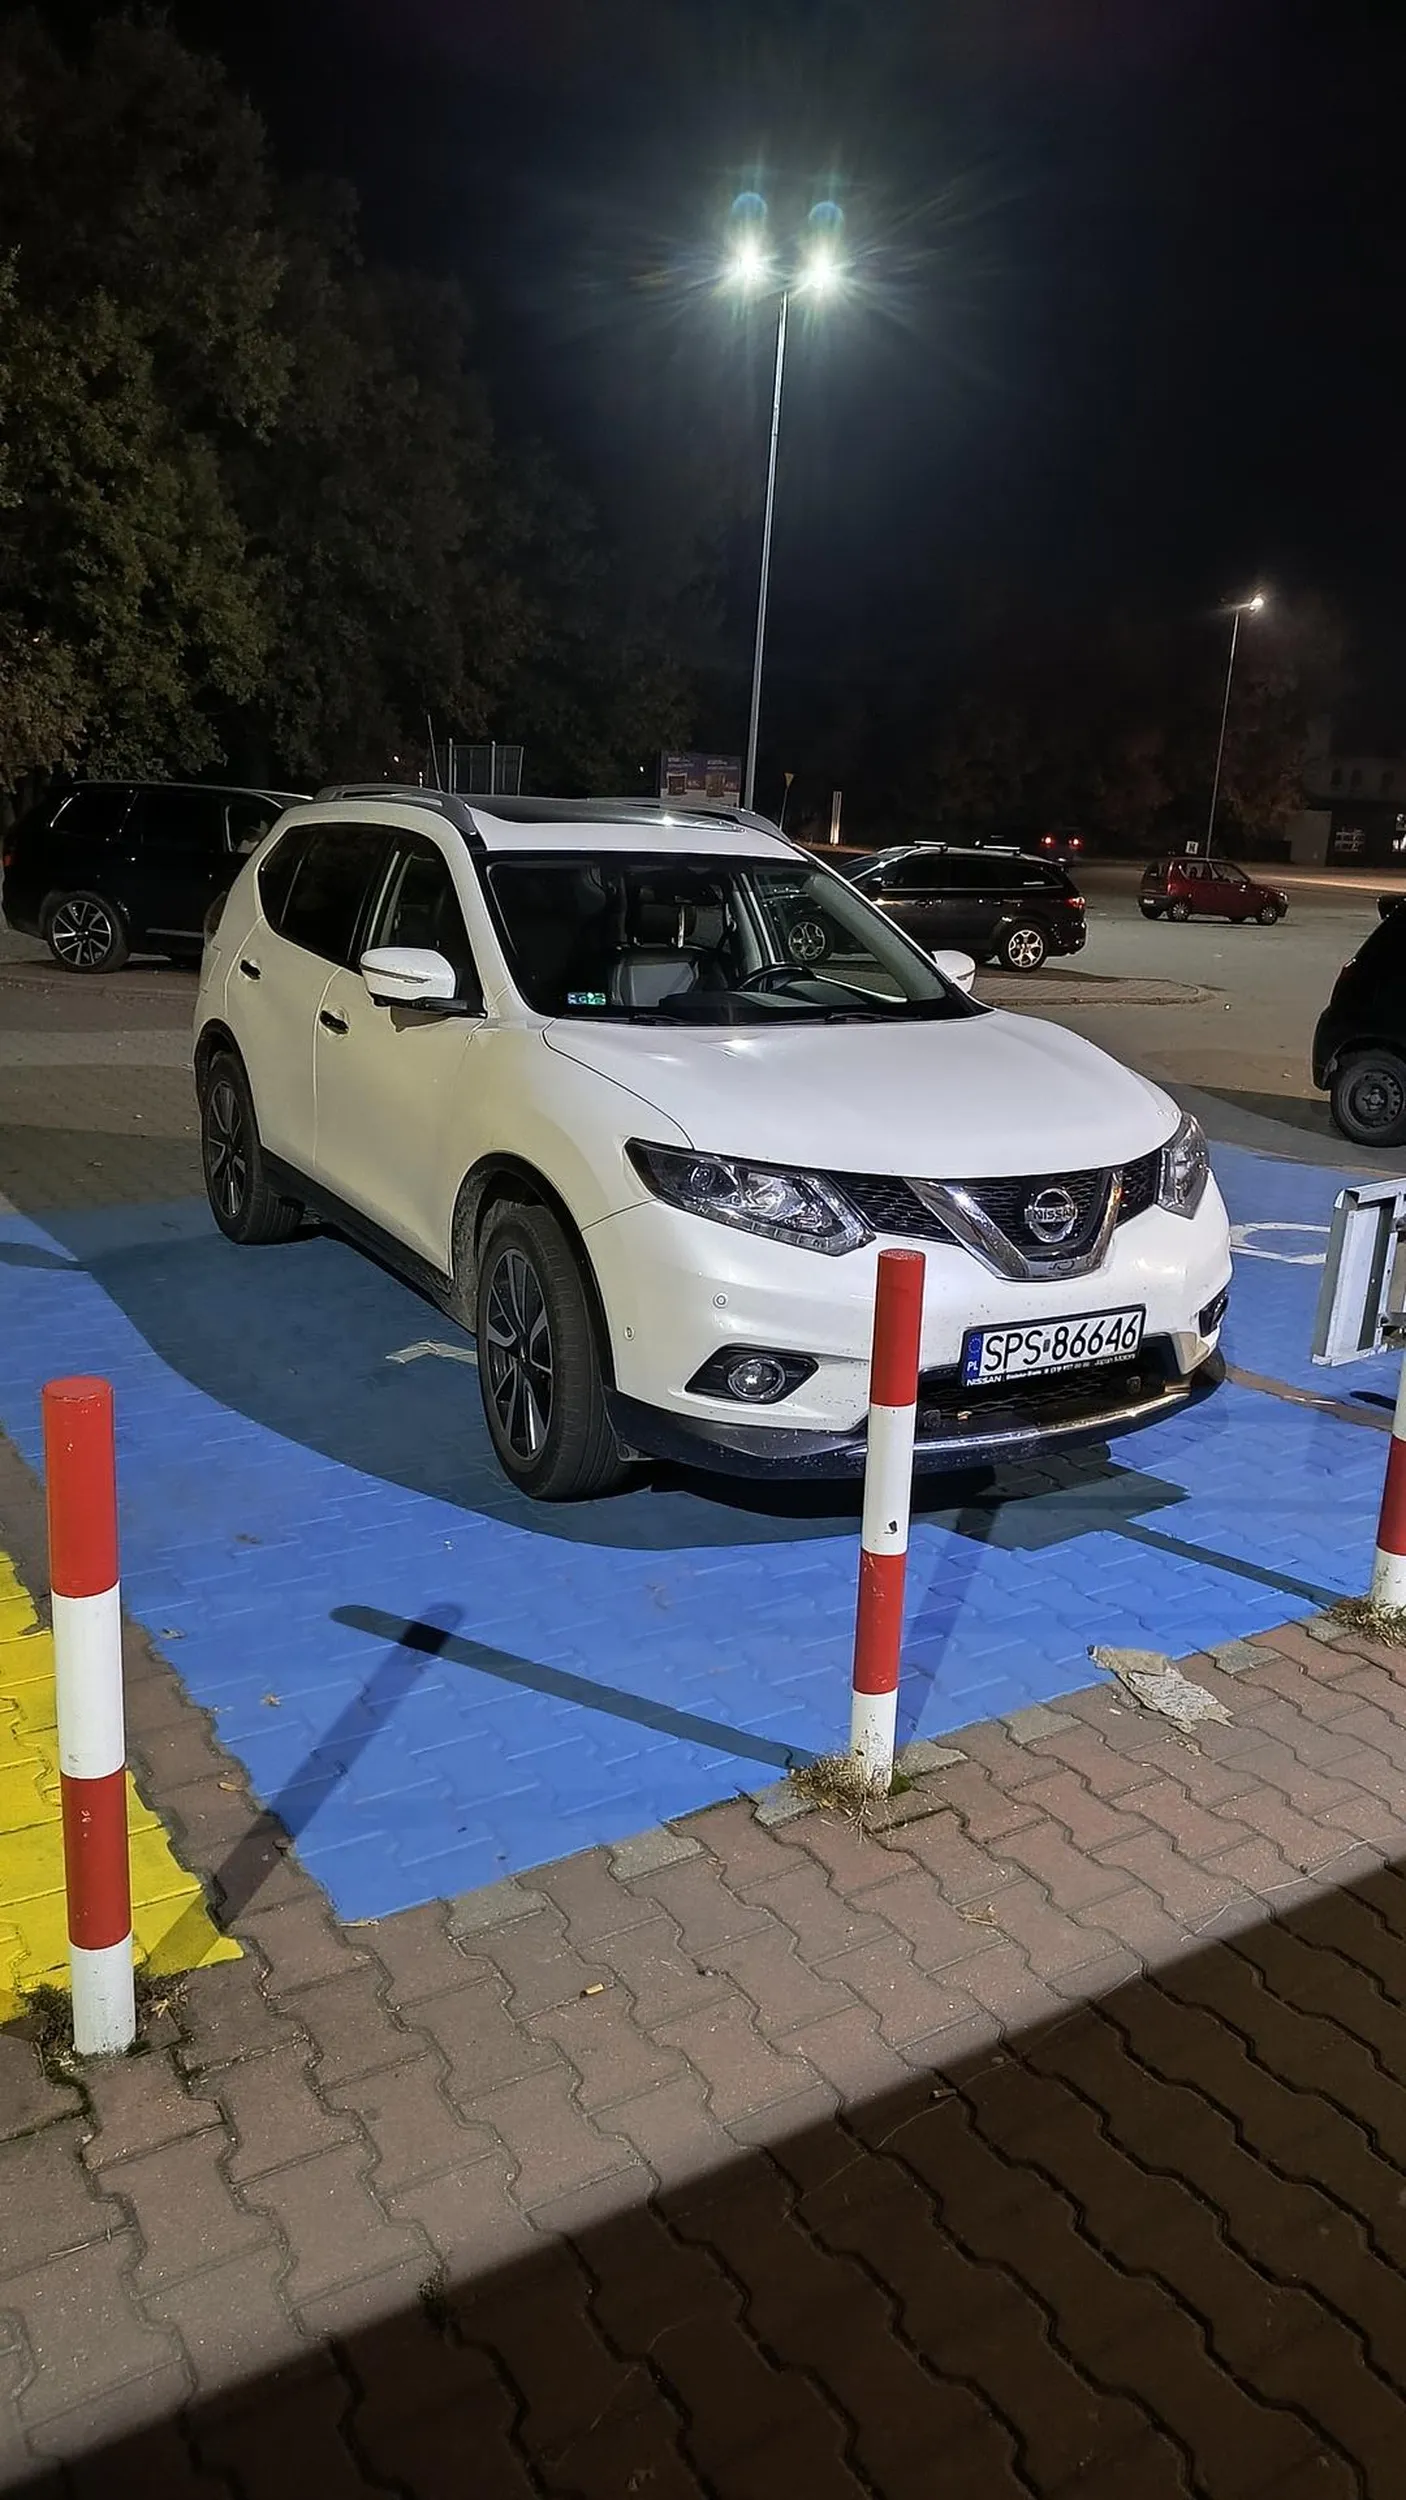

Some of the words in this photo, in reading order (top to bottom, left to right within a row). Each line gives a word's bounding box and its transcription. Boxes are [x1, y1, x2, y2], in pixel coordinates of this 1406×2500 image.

[985, 1331, 1043, 1371] SPS
[1052, 1314, 1139, 1361] 86646
[966, 1360, 979, 1373] PL
[966, 1375, 1002, 1387] NISSAN
